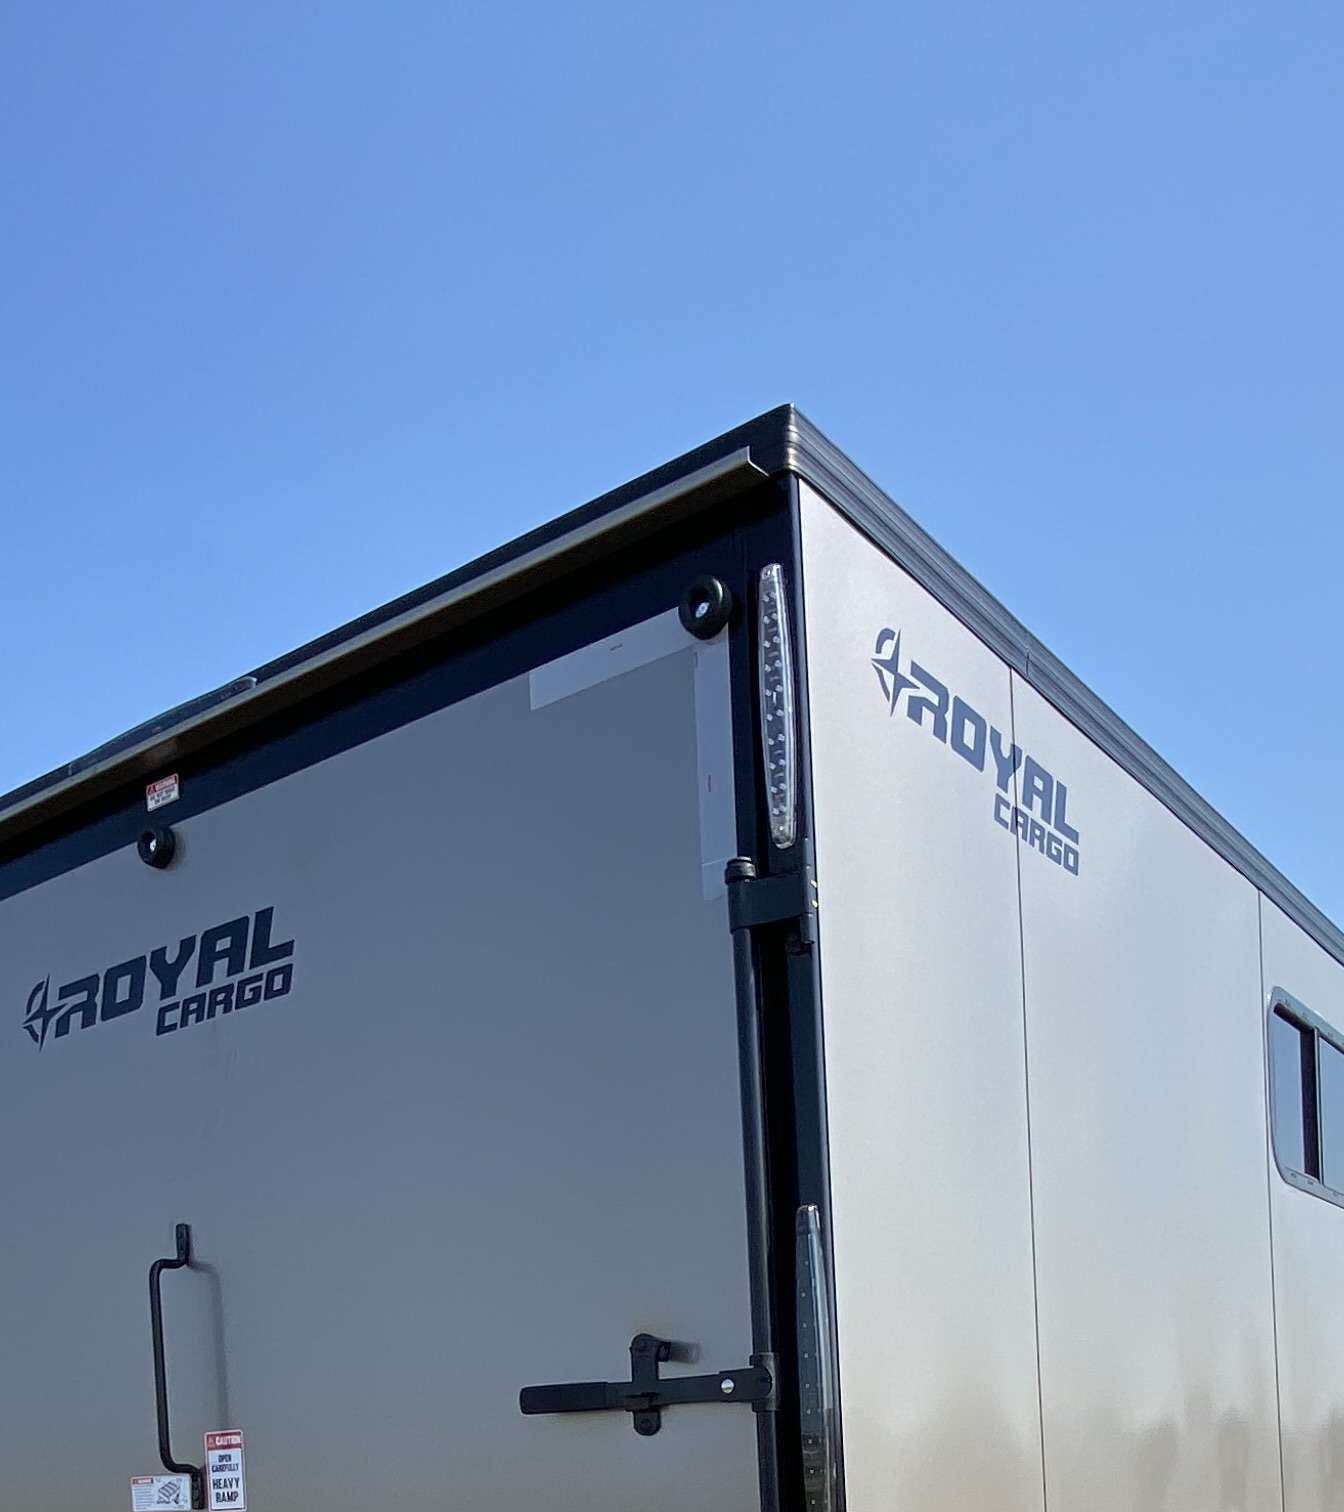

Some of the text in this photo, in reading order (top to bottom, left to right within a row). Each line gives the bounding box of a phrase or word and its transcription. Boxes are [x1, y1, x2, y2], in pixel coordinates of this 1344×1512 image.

[906, 659, 1080, 846] ROYAL
[993, 792, 1080, 877] CARGO
[54, 905, 296, 1039] ROYAL
[155, 962, 294, 1037] CARGO
[212, 1477, 240, 1490] HEAVY
[215, 1491, 239, 1503] RAMP
